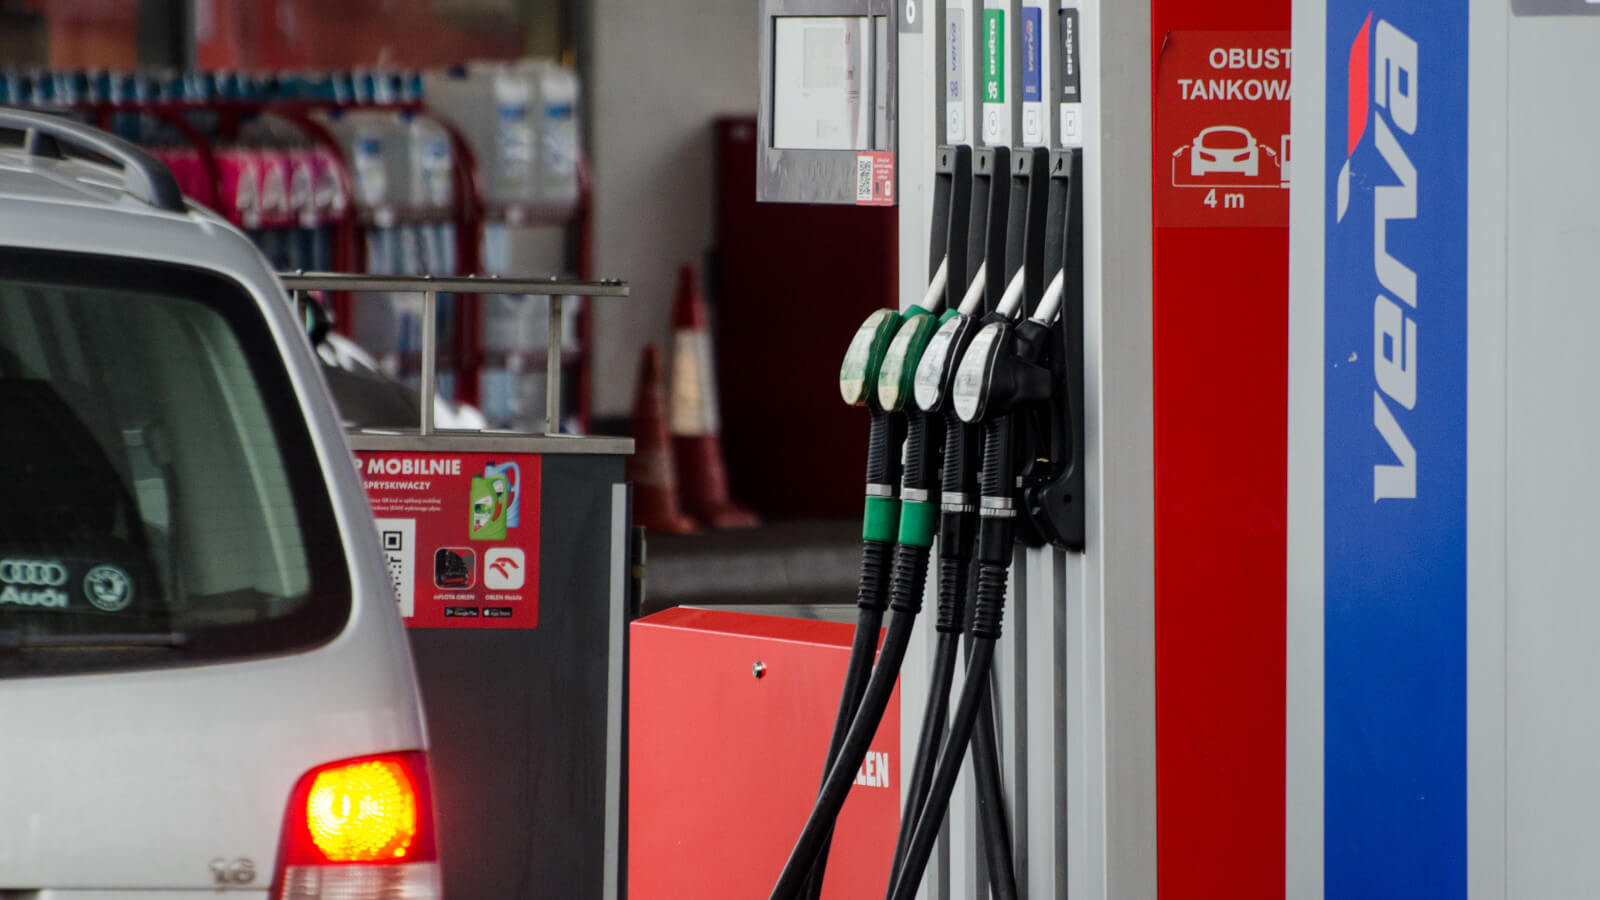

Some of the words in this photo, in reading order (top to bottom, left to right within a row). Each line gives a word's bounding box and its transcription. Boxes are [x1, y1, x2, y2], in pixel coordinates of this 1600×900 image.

[1203, 188, 1218, 208] 4
[1224, 193, 1245, 208] m
[1374, 18, 1418, 504] verva
[367, 458, 462, 475] MOBILNIE
[363, 481, 431, 490] SPRYSKIWACZY
[0, 585, 68, 607] Audi
[853, 751, 889, 788] LEN
